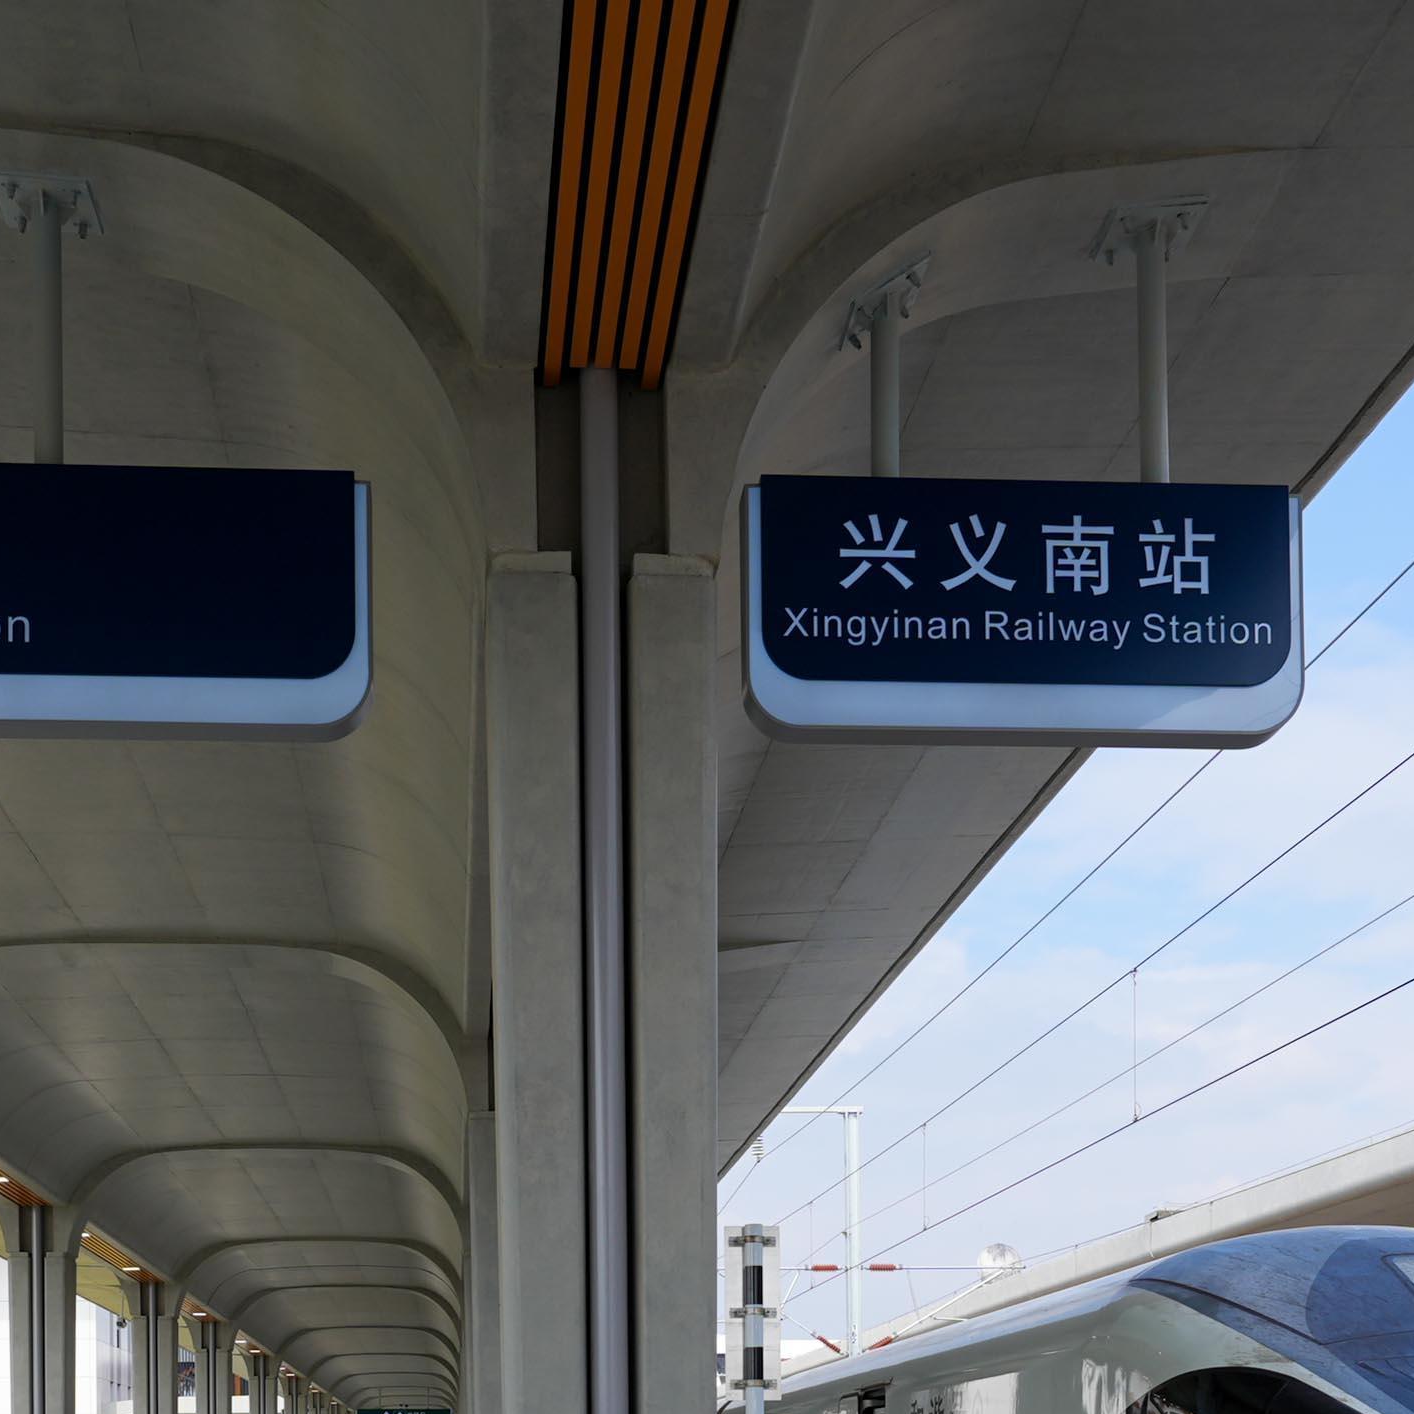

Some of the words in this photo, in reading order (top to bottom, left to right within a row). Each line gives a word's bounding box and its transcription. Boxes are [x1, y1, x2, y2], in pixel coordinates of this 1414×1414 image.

[838, 513, 1217, 597] 兴义南站
[783, 606, 971, 646] Xingyinan
[984, 610, 1132, 650] Railway
[1141, 612, 1273, 645] Station
